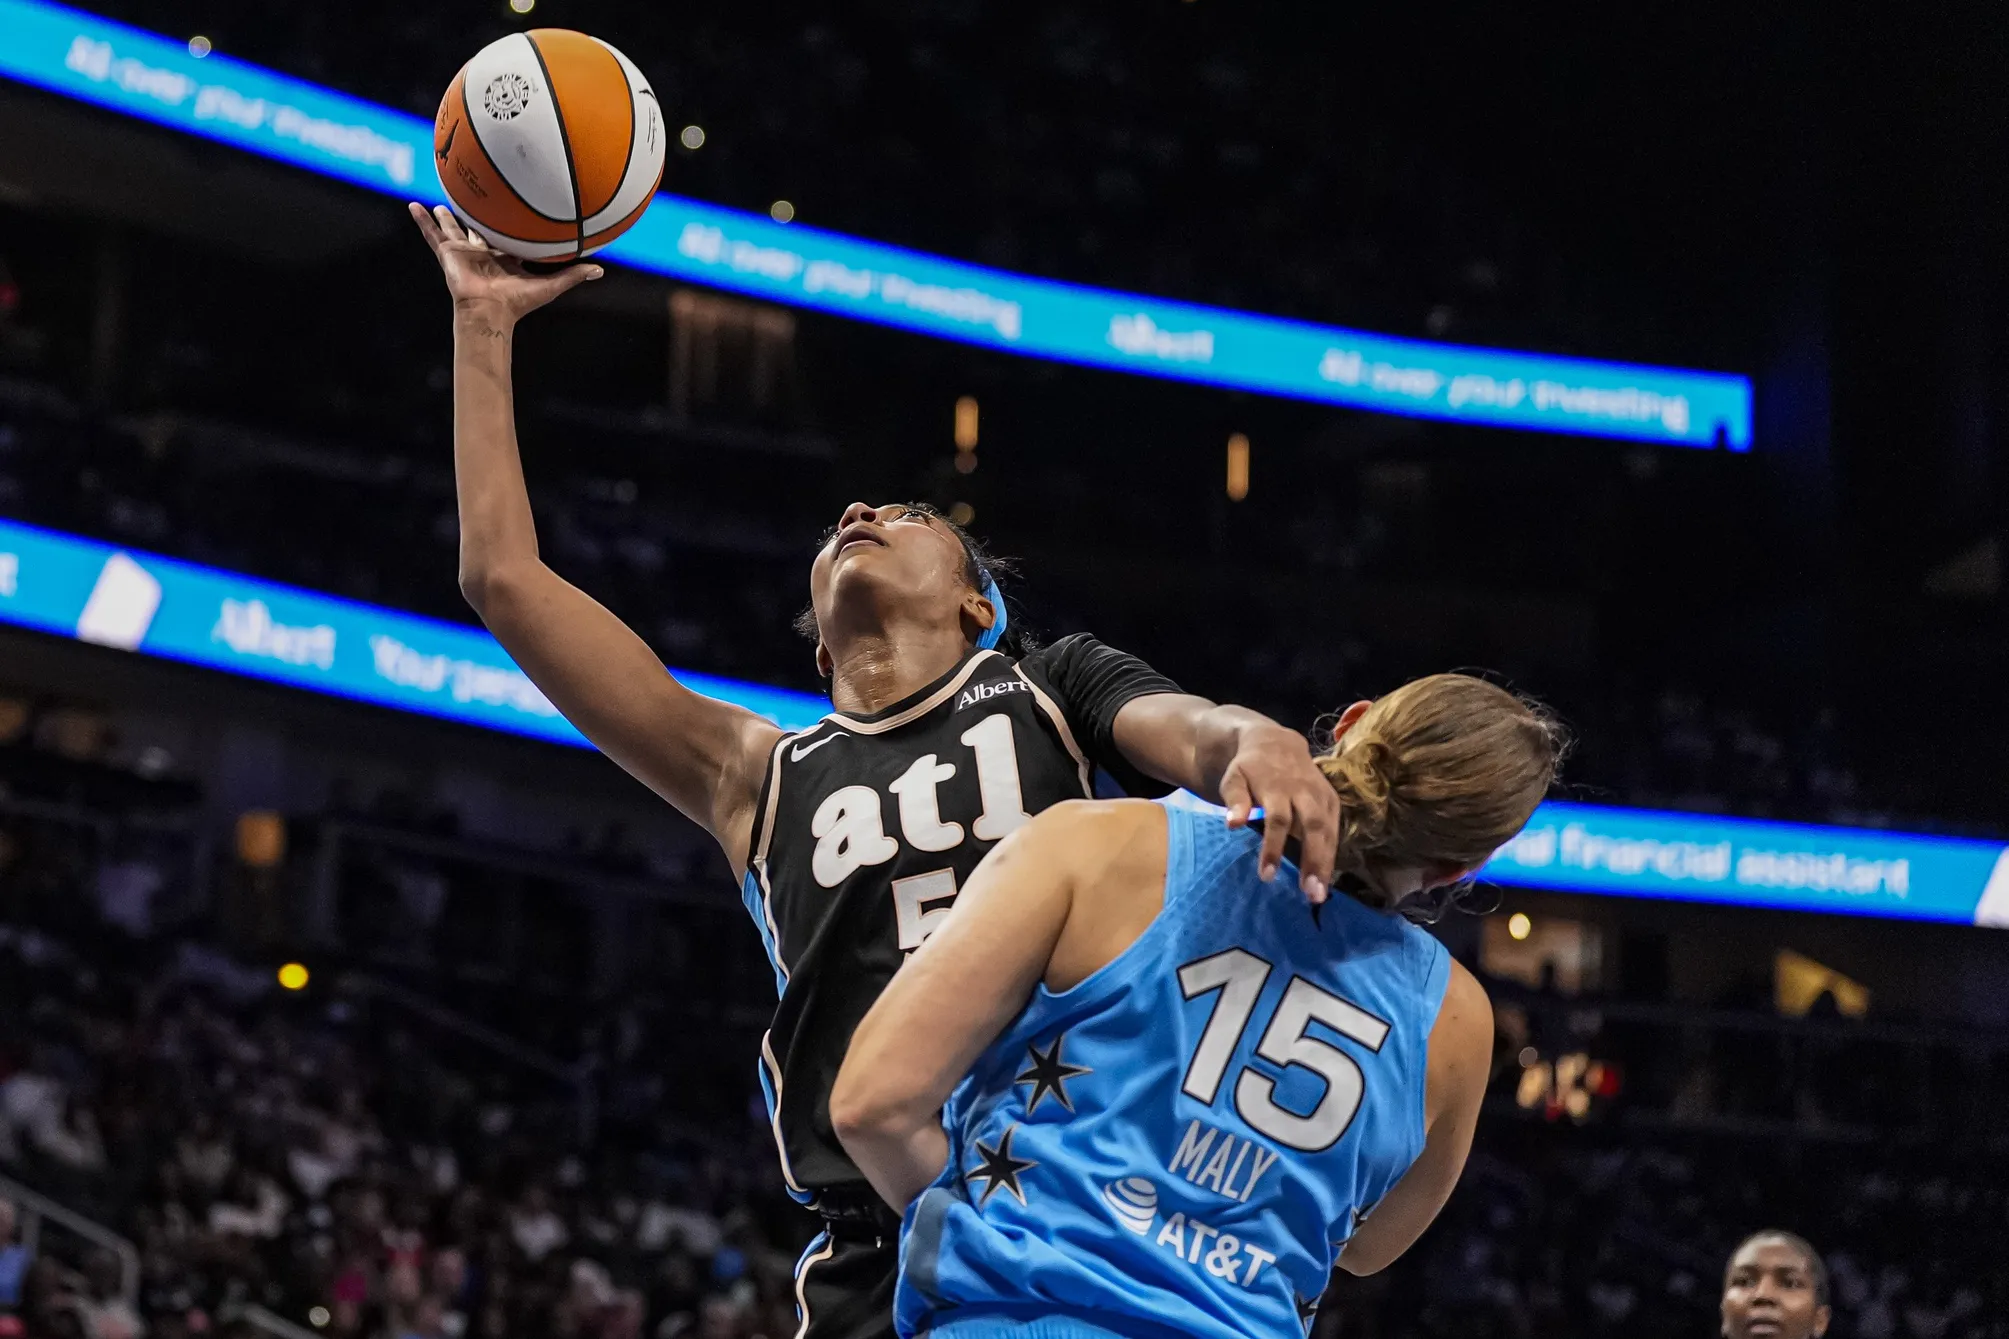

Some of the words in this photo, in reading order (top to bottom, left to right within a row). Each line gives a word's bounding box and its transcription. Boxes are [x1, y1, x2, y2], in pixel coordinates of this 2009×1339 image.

[210, 597, 337, 671] Albert
[369, 633, 450, 693] Your
[957, 679, 1029, 710] Albert
[811, 713, 1034, 889] atl
[1560, 822, 1732, 882] financial
[1736, 848, 1910, 900] assistant
[1176, 946, 1392, 1153] 15
[1168, 1119, 1280, 1203] MALY
[1156, 1210, 1277, 1288] AT&T
